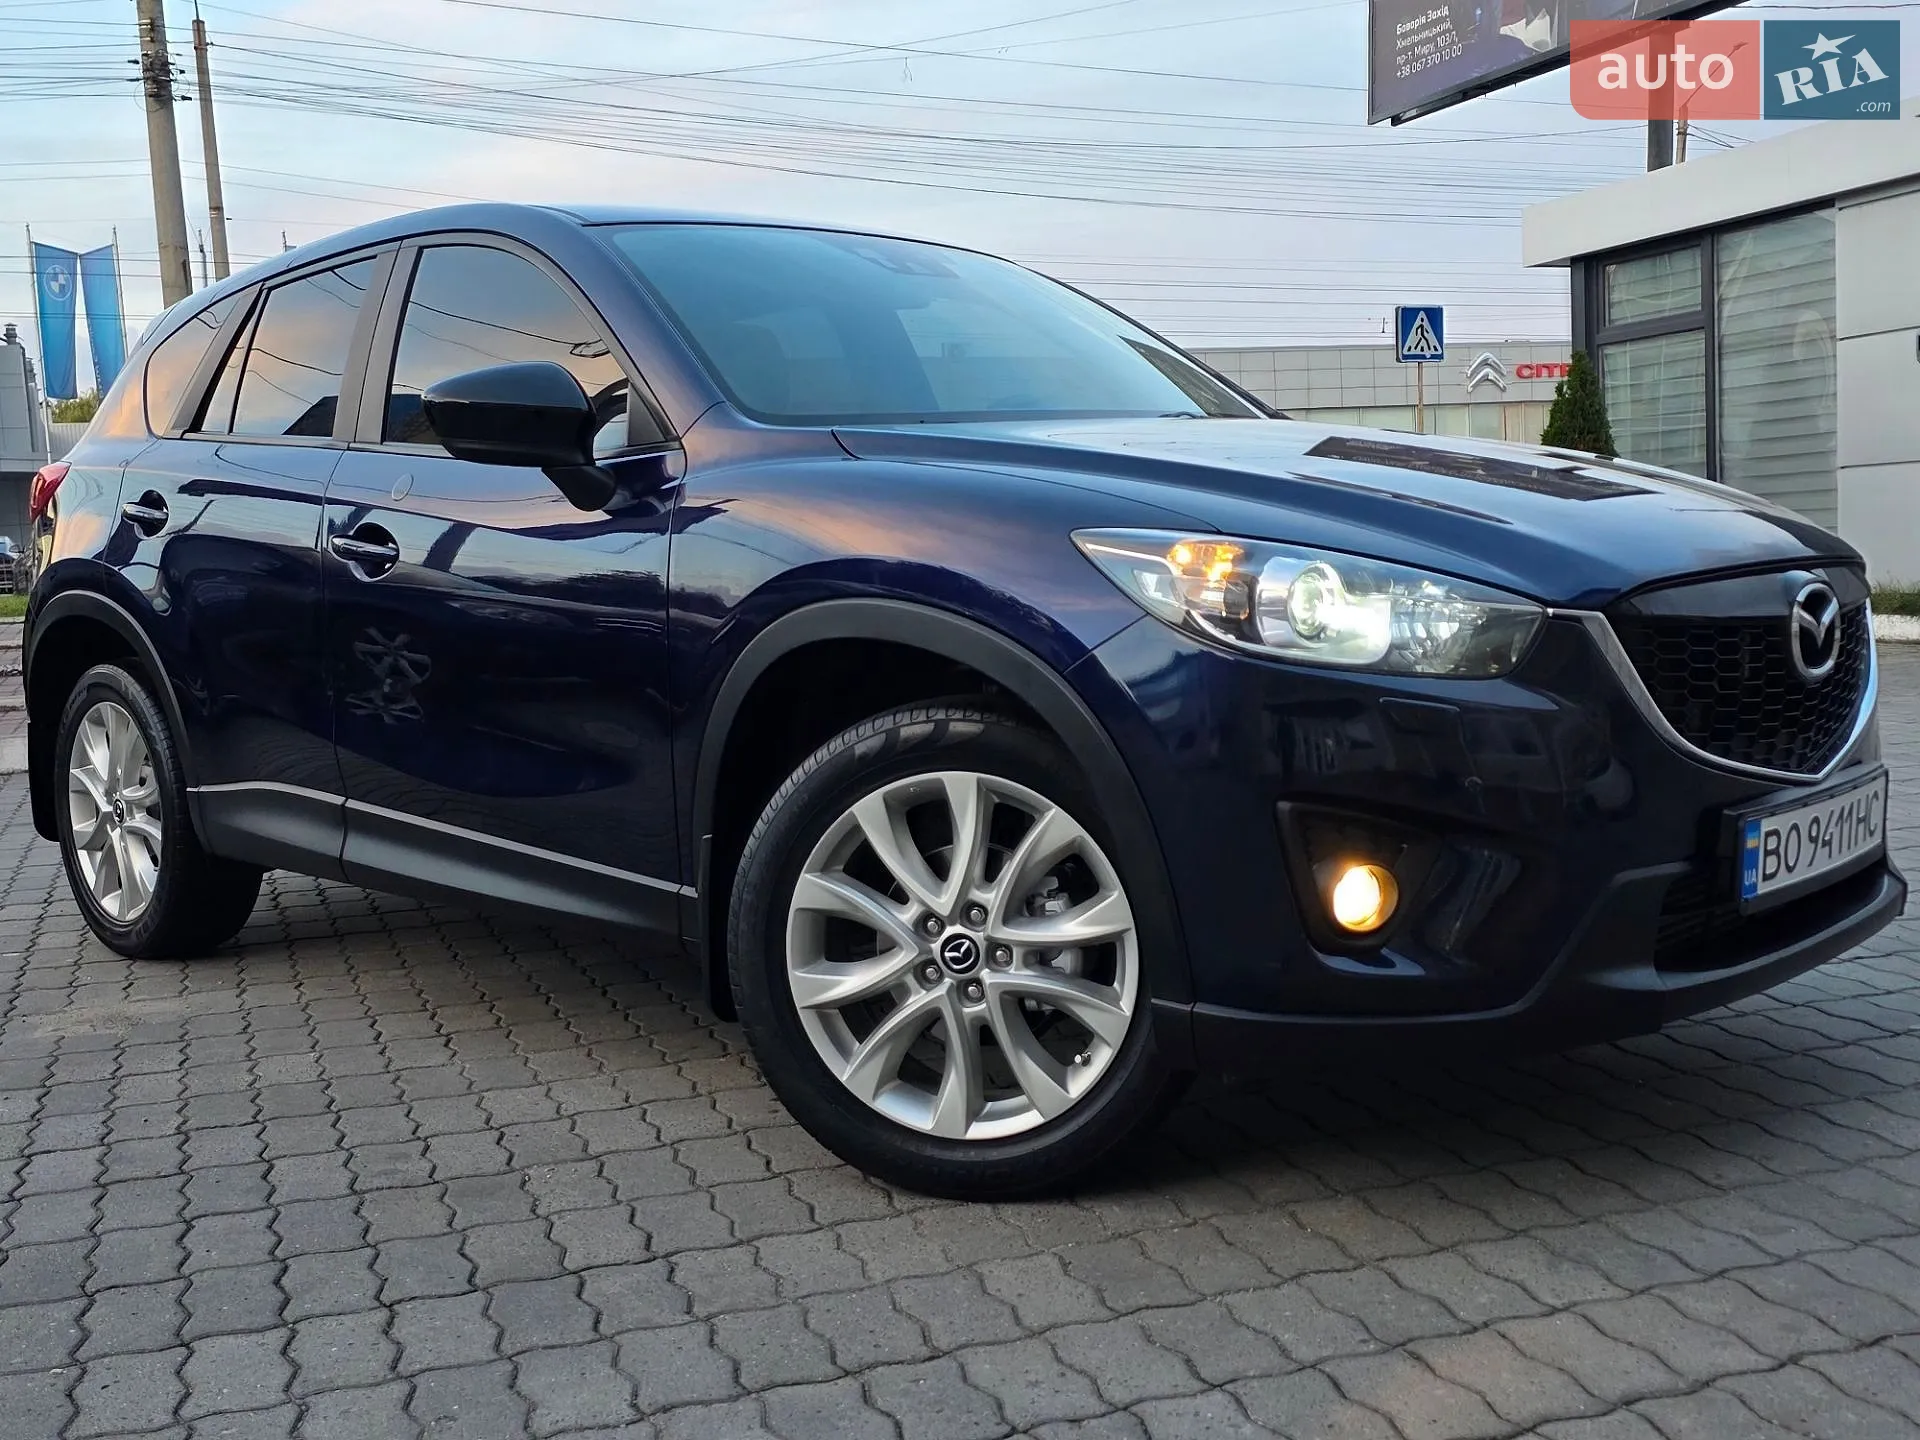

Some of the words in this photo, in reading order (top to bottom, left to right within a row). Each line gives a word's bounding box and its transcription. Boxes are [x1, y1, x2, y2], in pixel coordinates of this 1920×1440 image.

[1426, 4, 1449, 22] Захід
[1396, 64, 1411, 79] +38
[1411, 58, 1426, 73] 067
[1426, 52, 1441, 68] 370
[1441, 48, 1451, 62] 10
[1451, 43, 1463, 58] 00
[1745, 869, 1757, 885] UA
